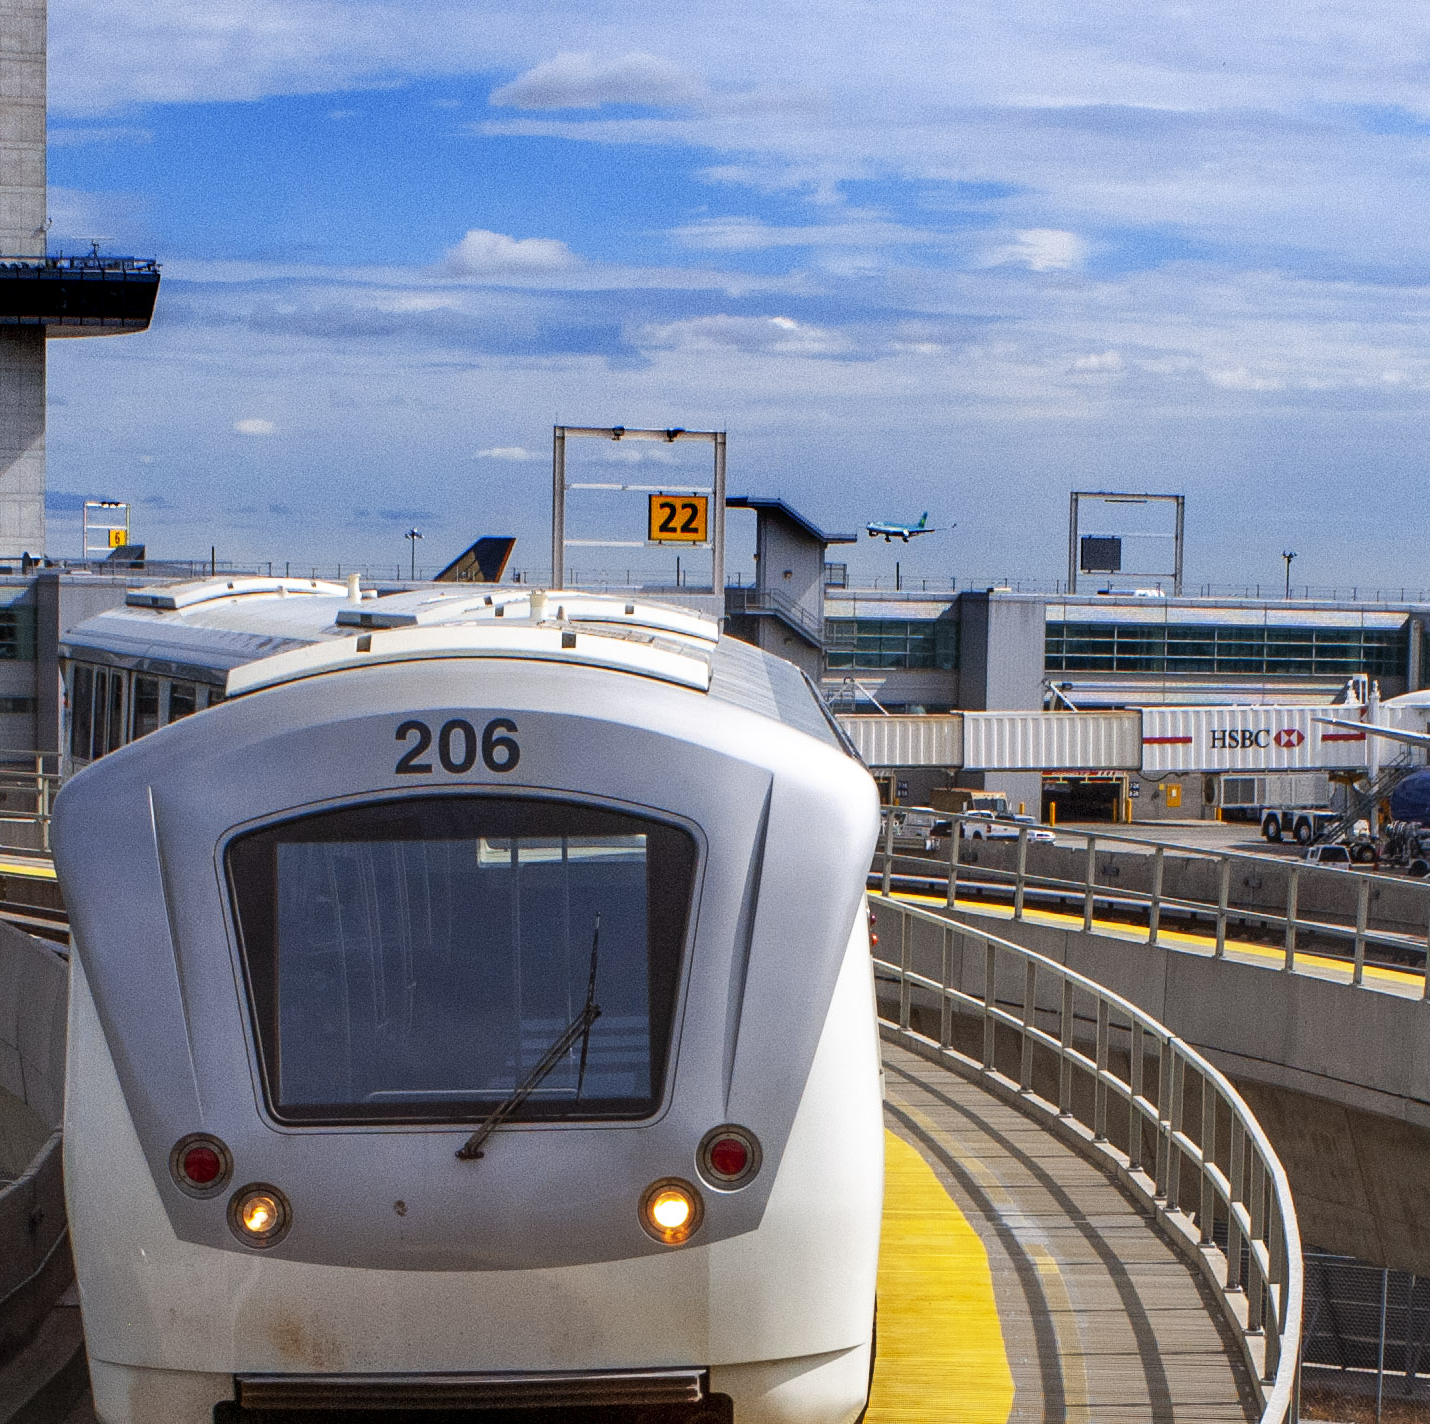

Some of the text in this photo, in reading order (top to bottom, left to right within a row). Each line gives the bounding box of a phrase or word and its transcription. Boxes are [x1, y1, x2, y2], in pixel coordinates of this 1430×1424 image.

[658, 502, 699, 534] 22
[394, 717, 521, 775] 206
[1210, 728, 1271, 749] HSBC
